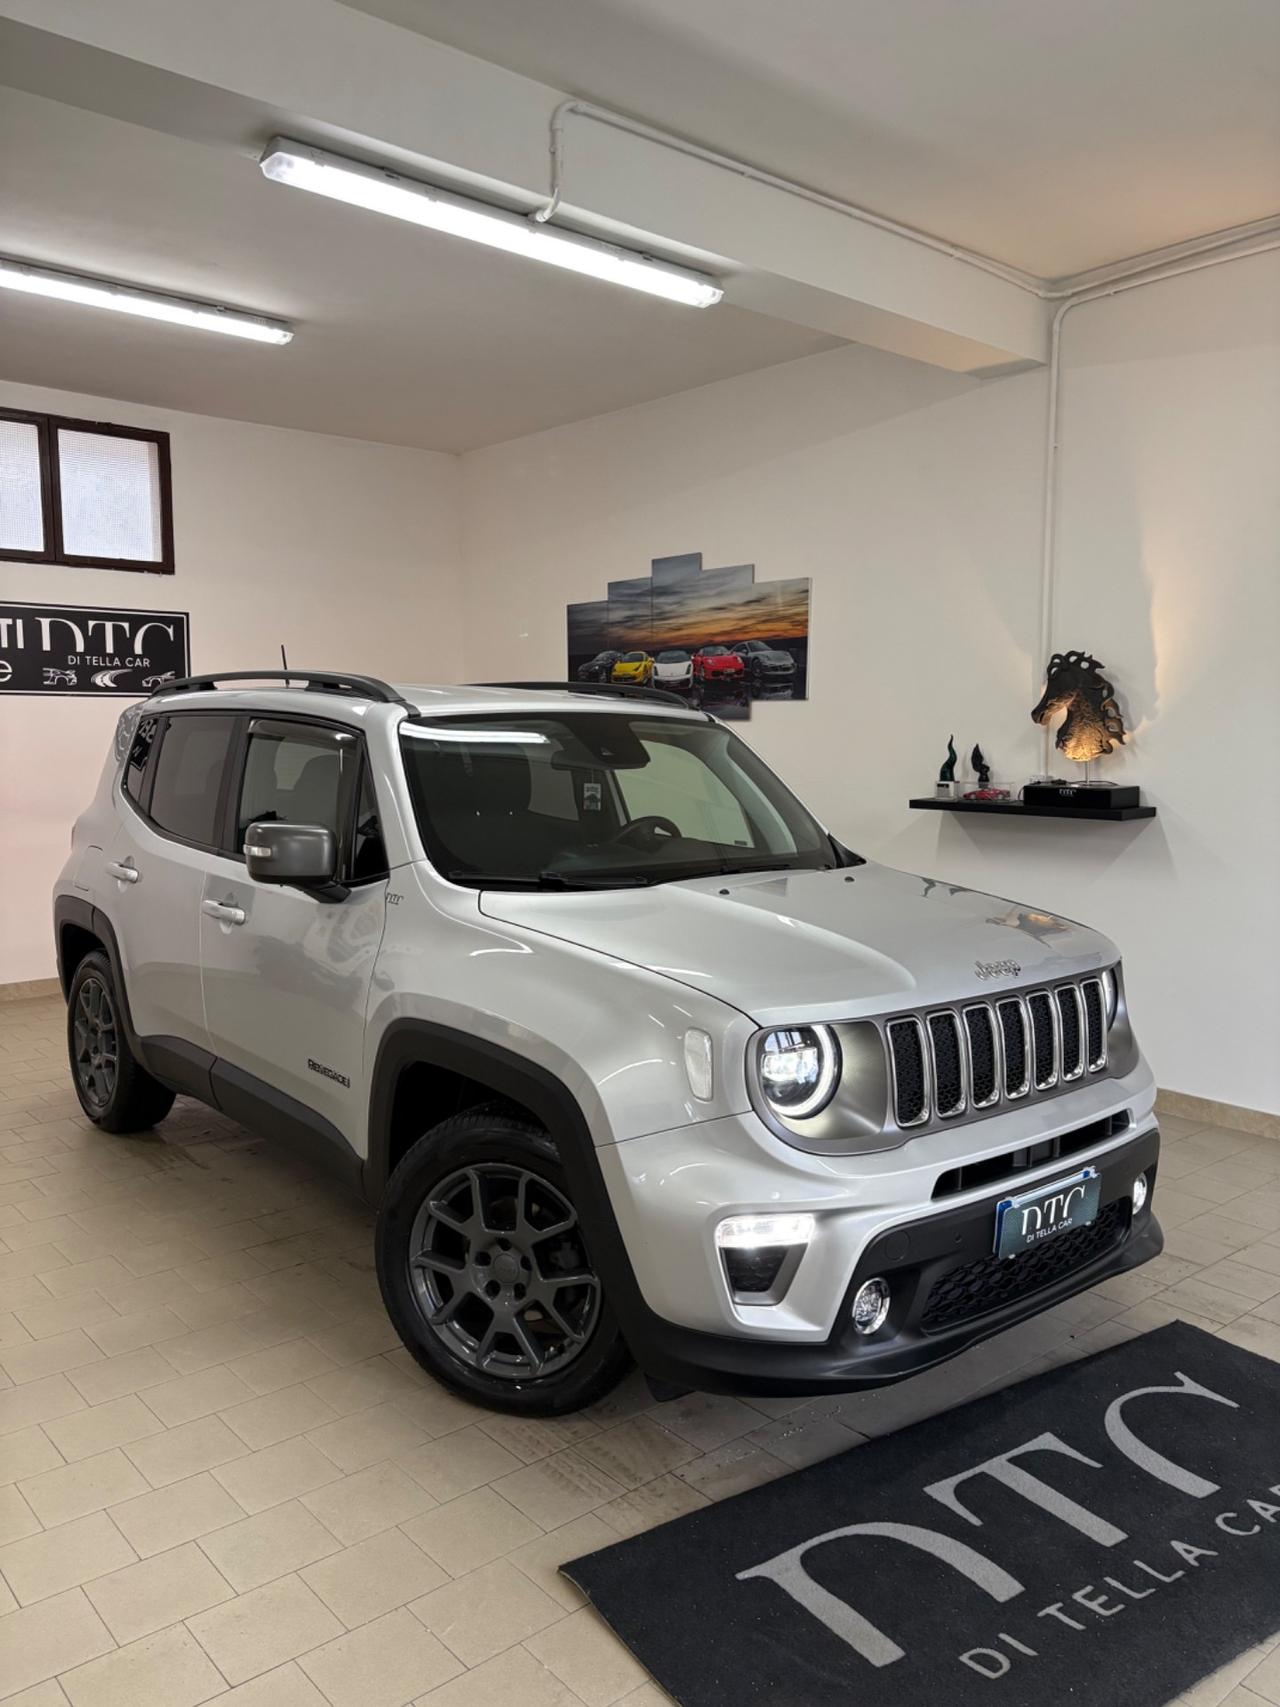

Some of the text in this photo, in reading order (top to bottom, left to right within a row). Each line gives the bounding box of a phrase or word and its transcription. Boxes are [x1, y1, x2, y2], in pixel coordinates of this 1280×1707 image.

[35, 617, 174, 655] DTC
[68, 655, 150, 667] DI TELLA CAR
[1021, 1185, 1086, 1235] DTC
[1026, 1218, 1073, 1243] DI TELLA CAR
[735, 1371, 1240, 1668] DTC
[958, 1484, 1280, 1680] DI TELLA CA
